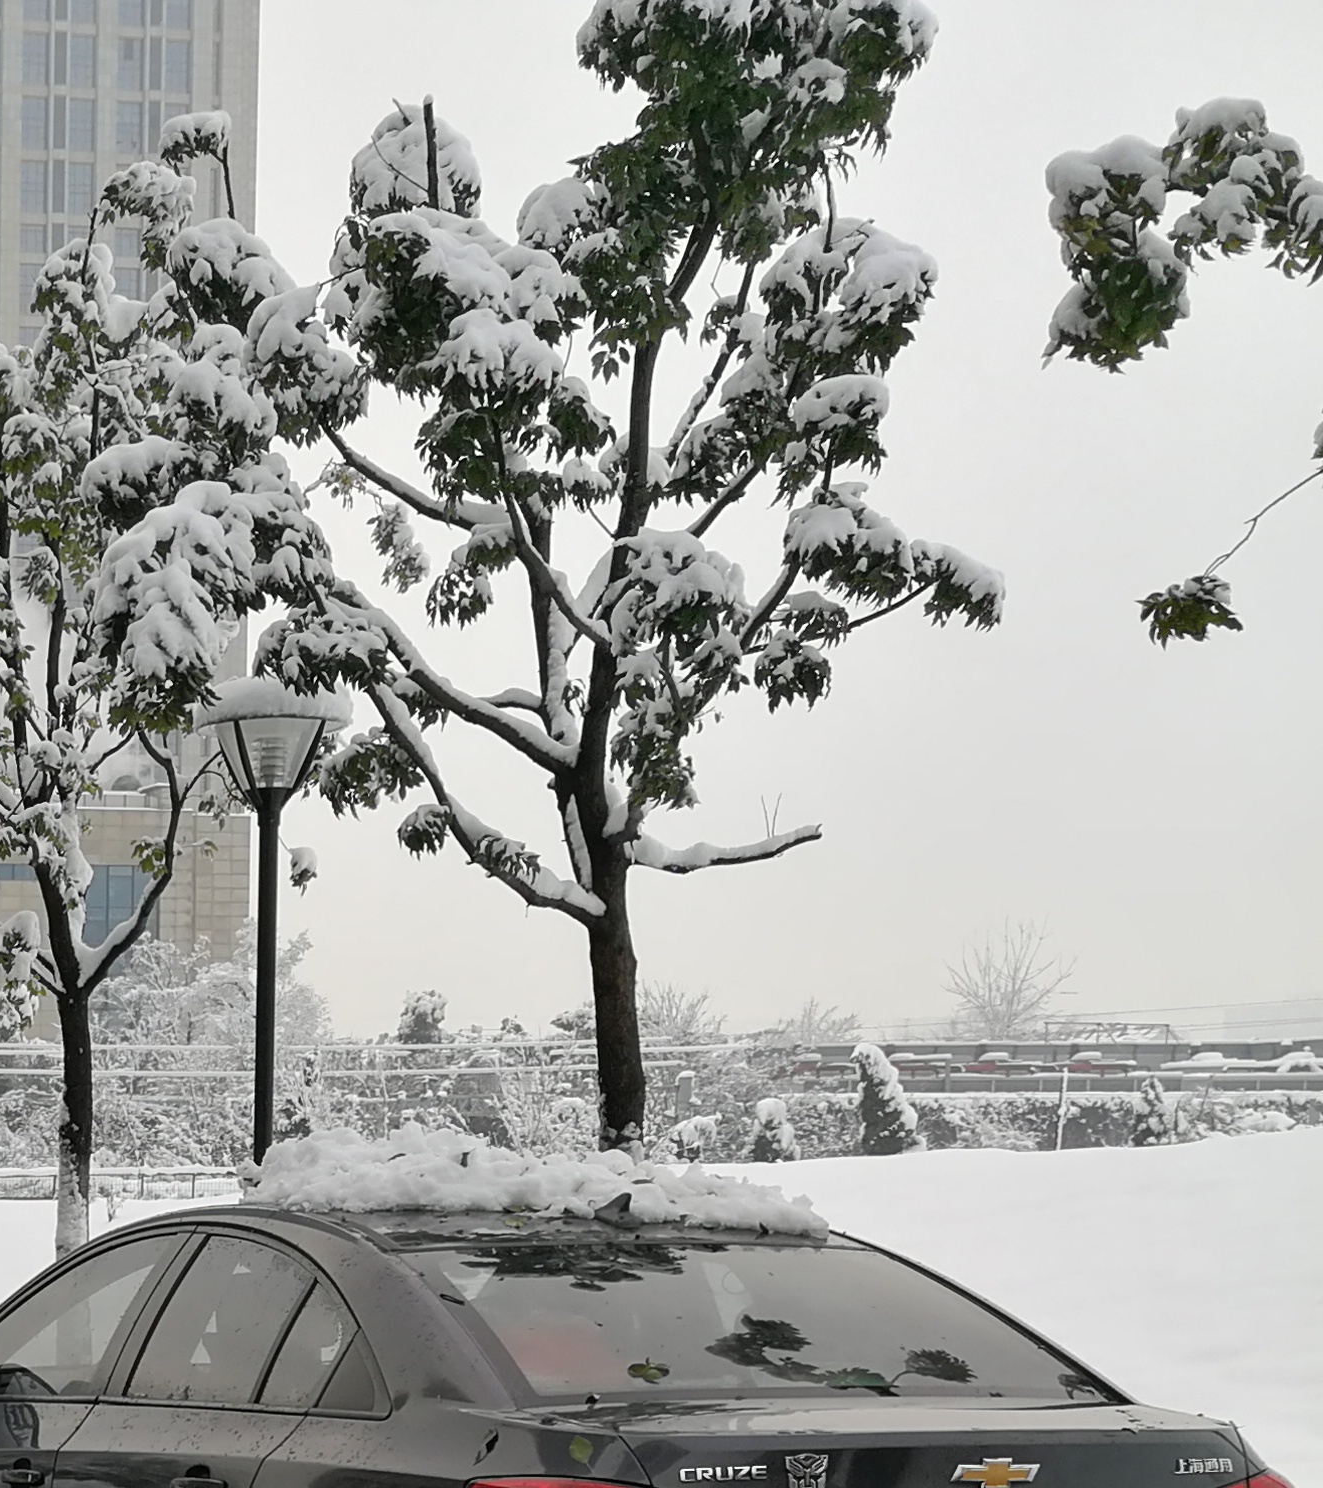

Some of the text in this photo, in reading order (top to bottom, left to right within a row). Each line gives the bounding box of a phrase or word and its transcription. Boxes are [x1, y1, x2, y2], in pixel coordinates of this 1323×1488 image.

[679, 1465, 767, 1482] CRUZE
[1174, 1458, 1233, 1475] 上海通用
